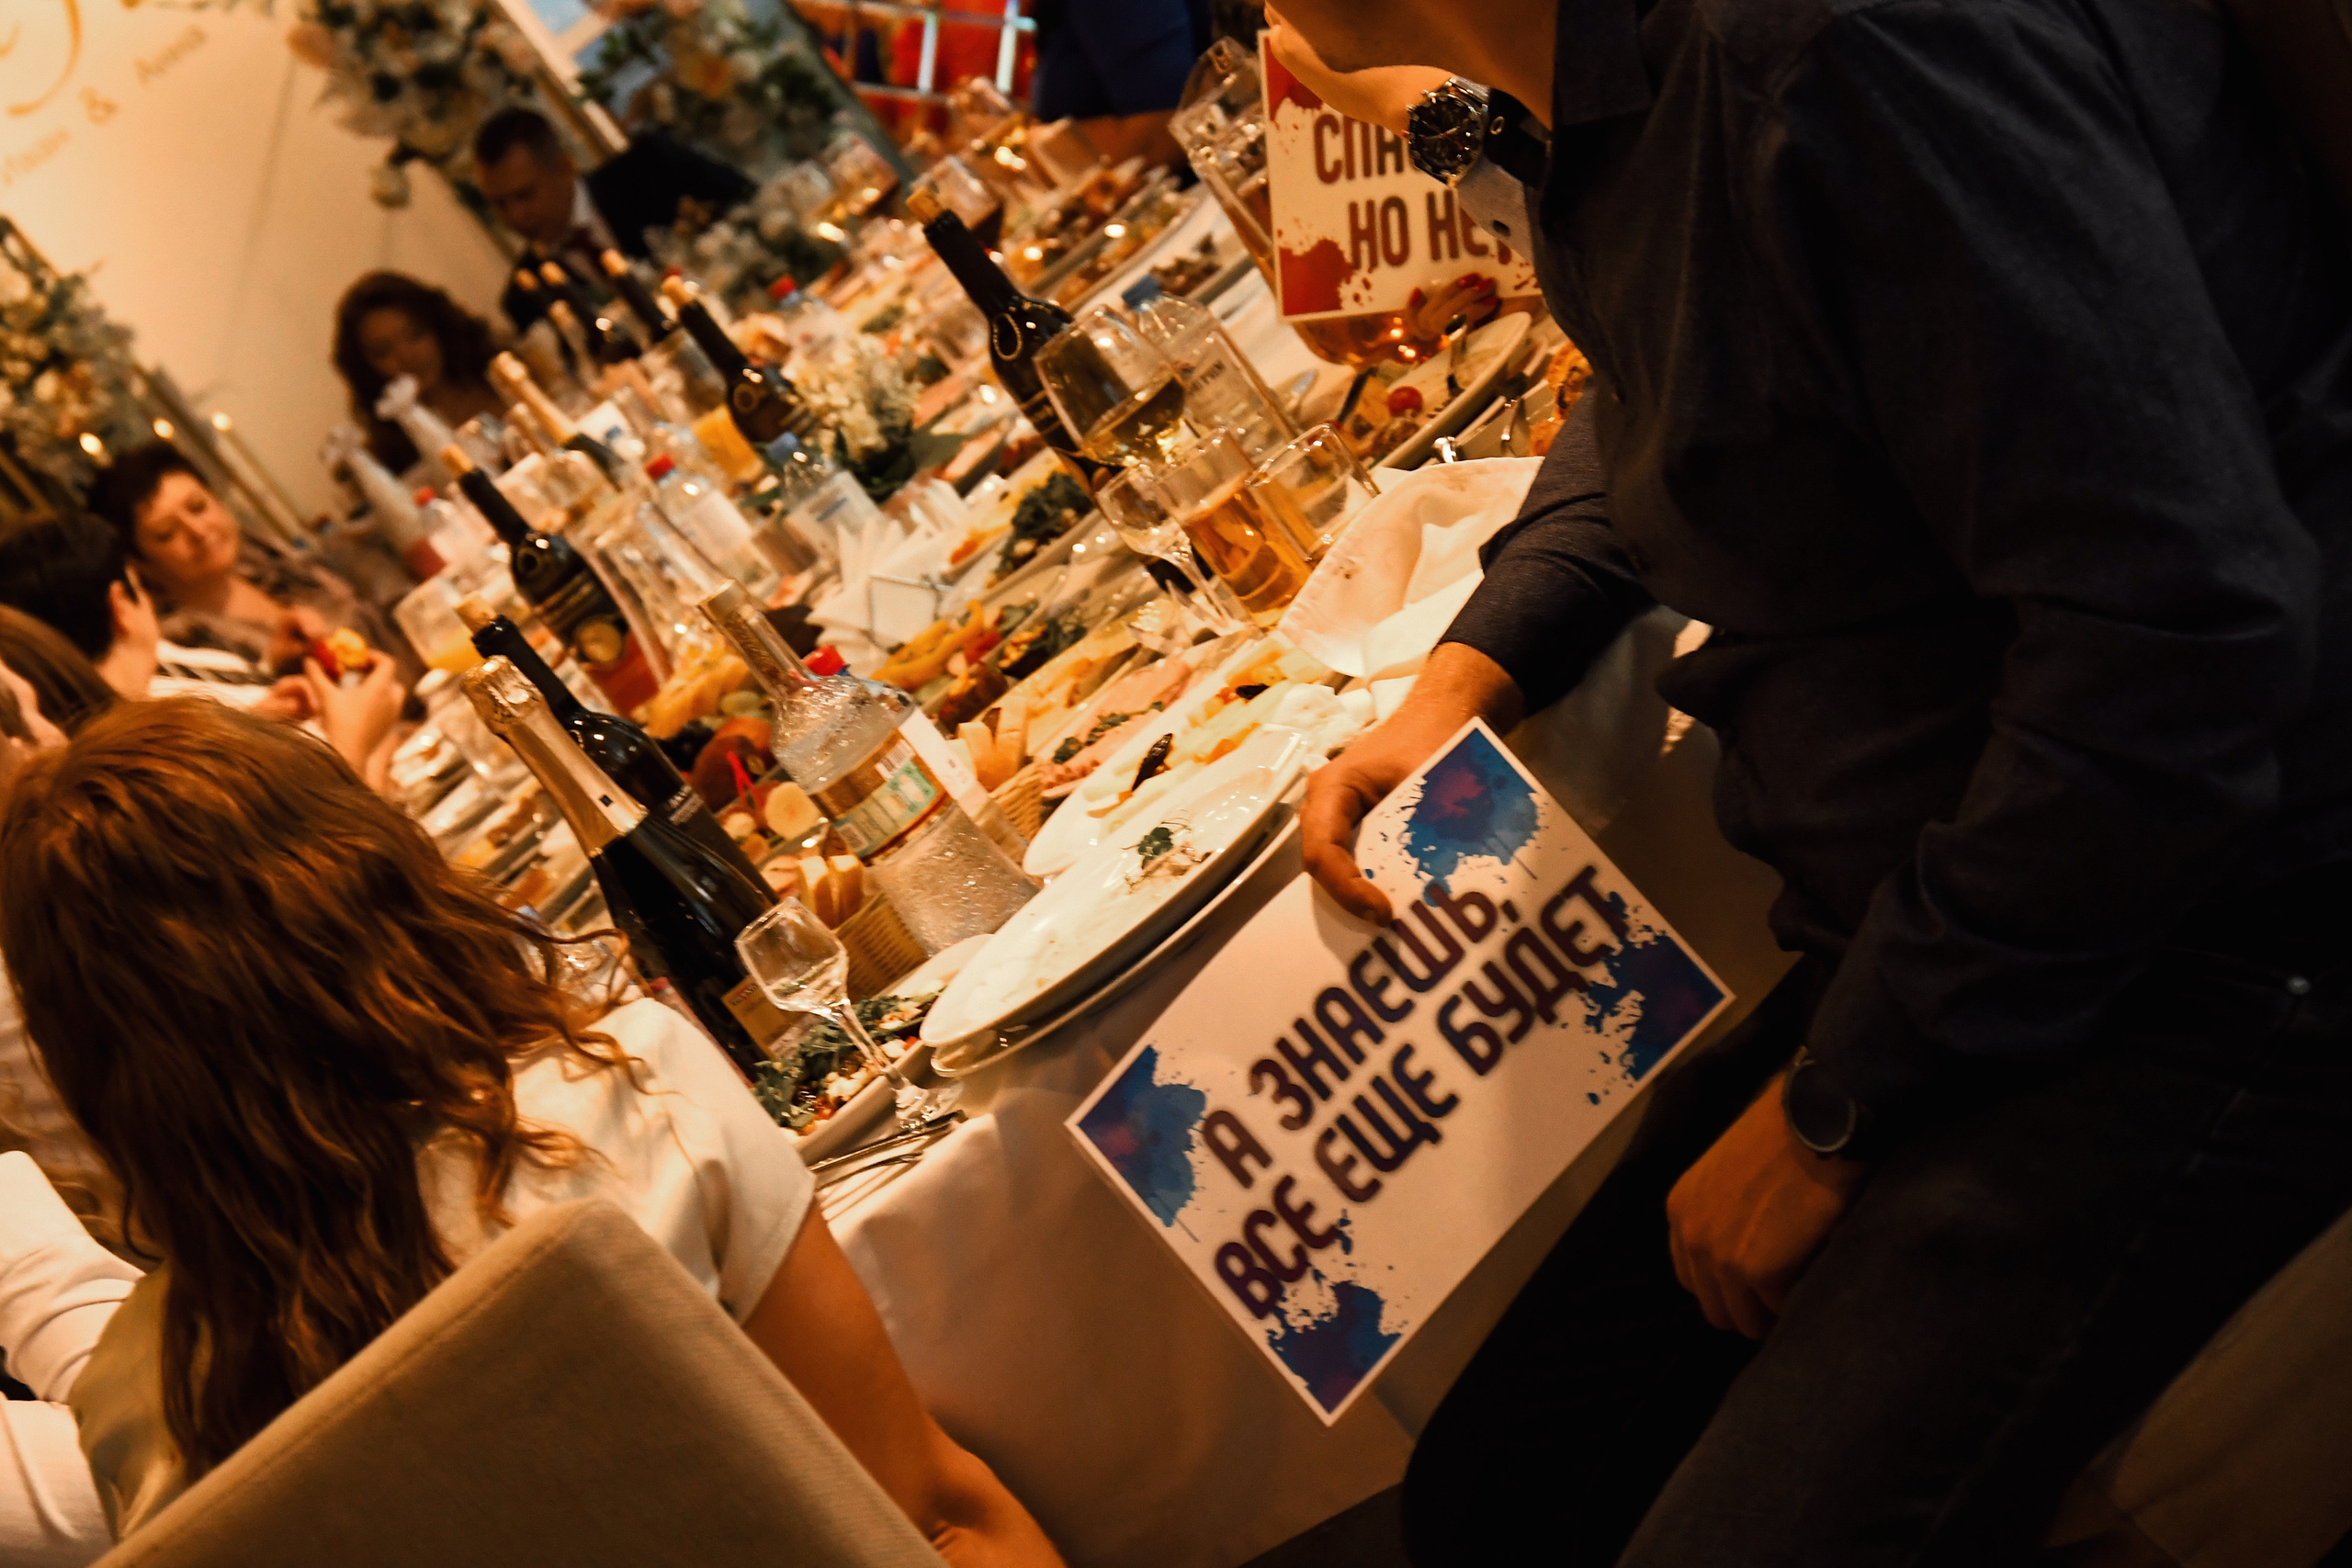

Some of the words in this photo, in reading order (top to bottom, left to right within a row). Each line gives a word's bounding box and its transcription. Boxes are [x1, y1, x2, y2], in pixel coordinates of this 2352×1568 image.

[1313, 113, 1425, 185] СПА
[1348, 196, 1411, 273] НО
[1202, 1109, 1273, 1187] А
[1250, 884, 1521, 1131] ЗНАЕШЬ,
[1214, 1174, 1339, 1320] ВСЕ
[1314, 1043, 1461, 1203] ЕЩЕ
[1436, 863, 1632, 1077] БУДЕТ
